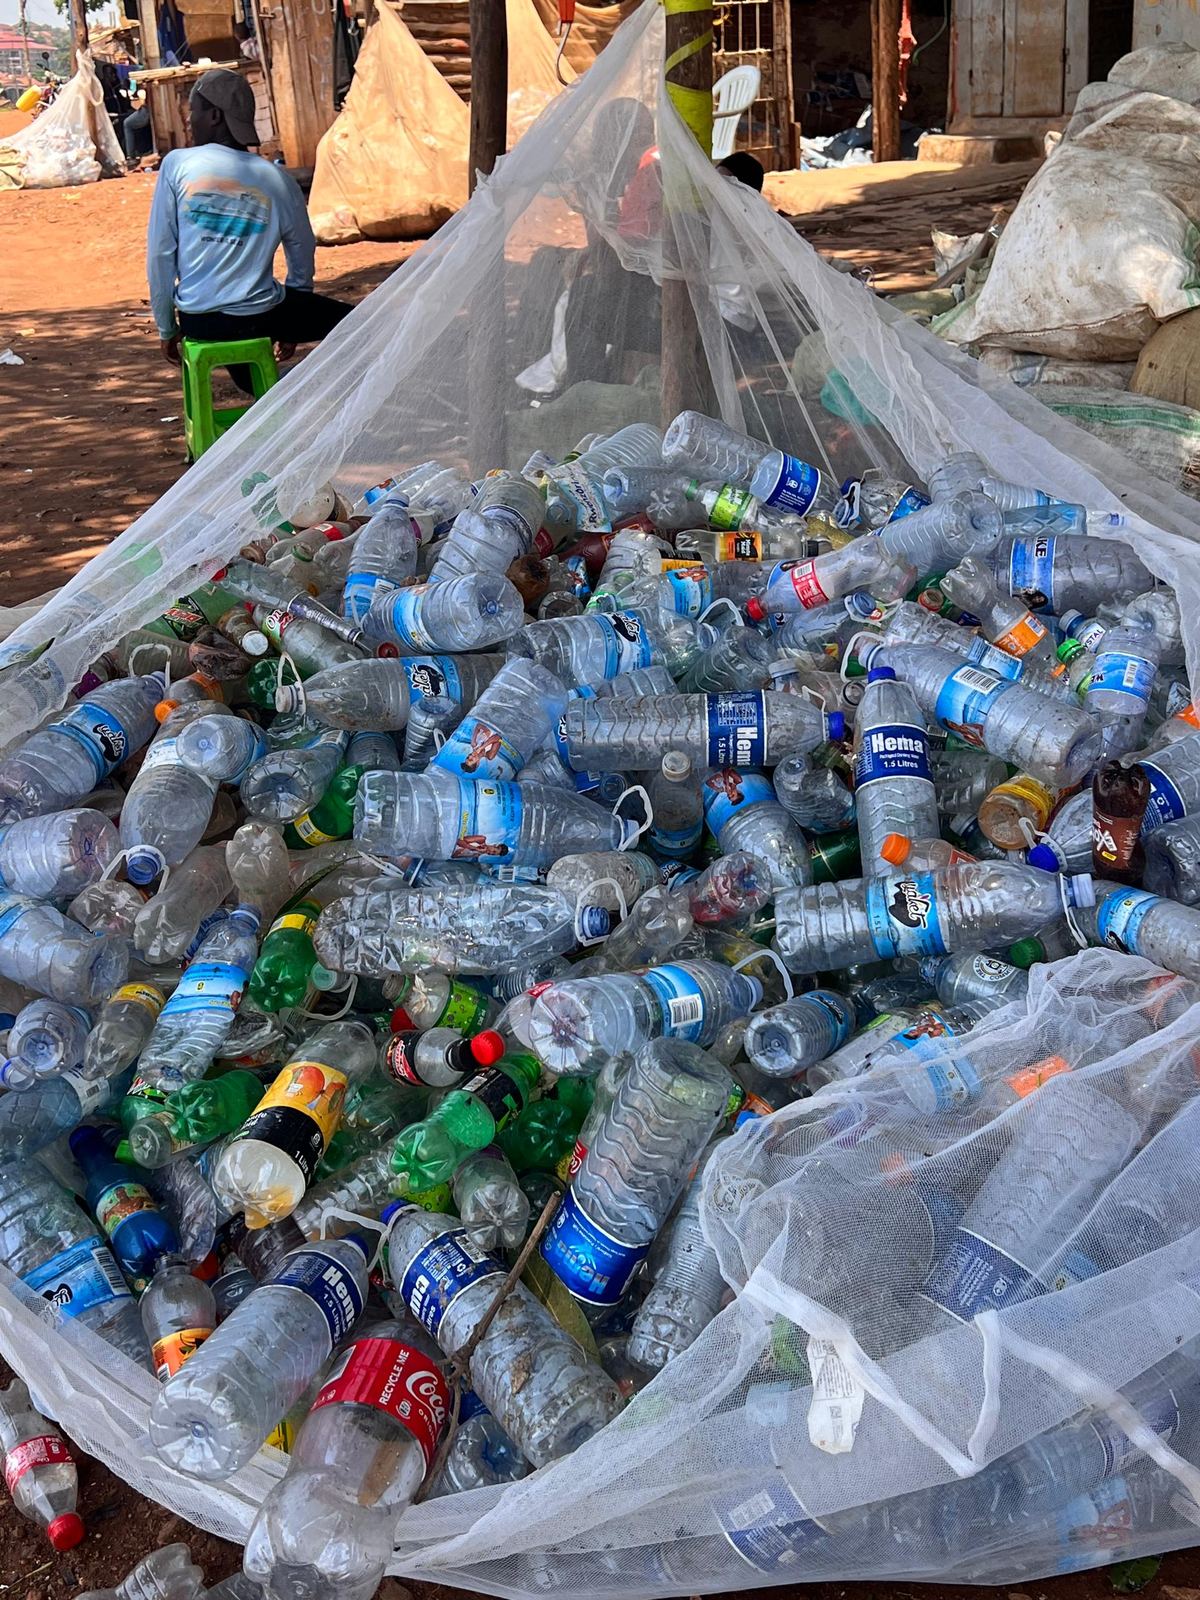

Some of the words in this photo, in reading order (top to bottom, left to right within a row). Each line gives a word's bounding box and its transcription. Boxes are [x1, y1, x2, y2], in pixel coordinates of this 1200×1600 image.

[1082, 628, 1104, 649] YSTAL
[871, 732, 924, 754] Hema
[883, 760, 896, 768] 1.5
[897, 759, 919, 769] Litres
[378, 1363, 404, 1405] RECYCLE
[399, 1349, 410, 1365] ME
